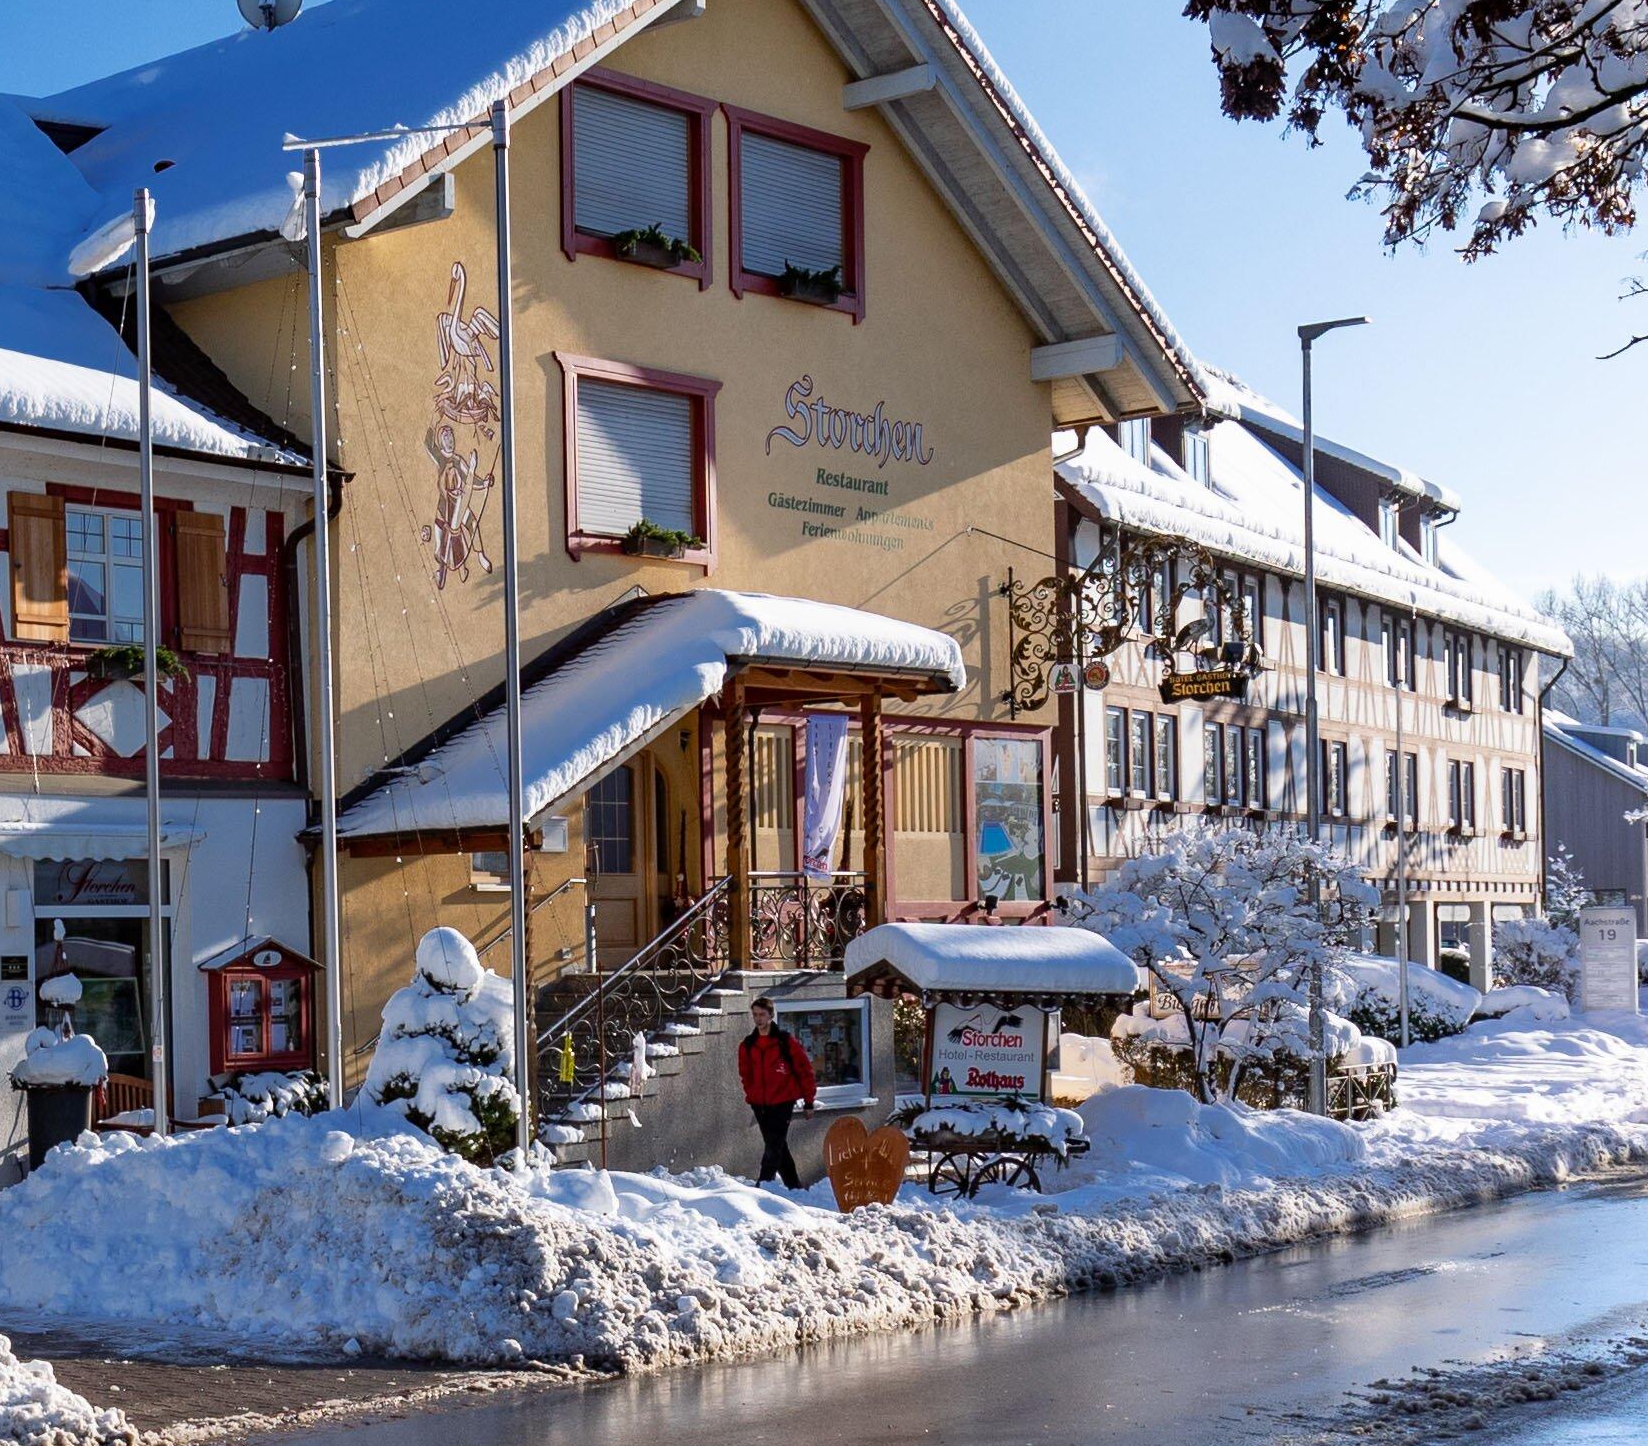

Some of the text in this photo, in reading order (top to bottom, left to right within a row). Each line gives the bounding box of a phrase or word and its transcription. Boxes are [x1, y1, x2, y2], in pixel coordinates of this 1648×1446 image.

[766, 374, 934, 469] Storchen
[816, 467, 889, 496] Restaurant
[768, 492, 934, 530] Gästezimmer Appartements
[802, 521, 904, 551] Ferienwohnungen
[1171, 681, 1231, 696] Storchen
[1584, 918, 1631, 927] Aachstraße
[1599, 929, 1617, 942] 19
[961, 1029, 1024, 1049] Storchen
[965, 1067, 1026, 1092] Rothaus
